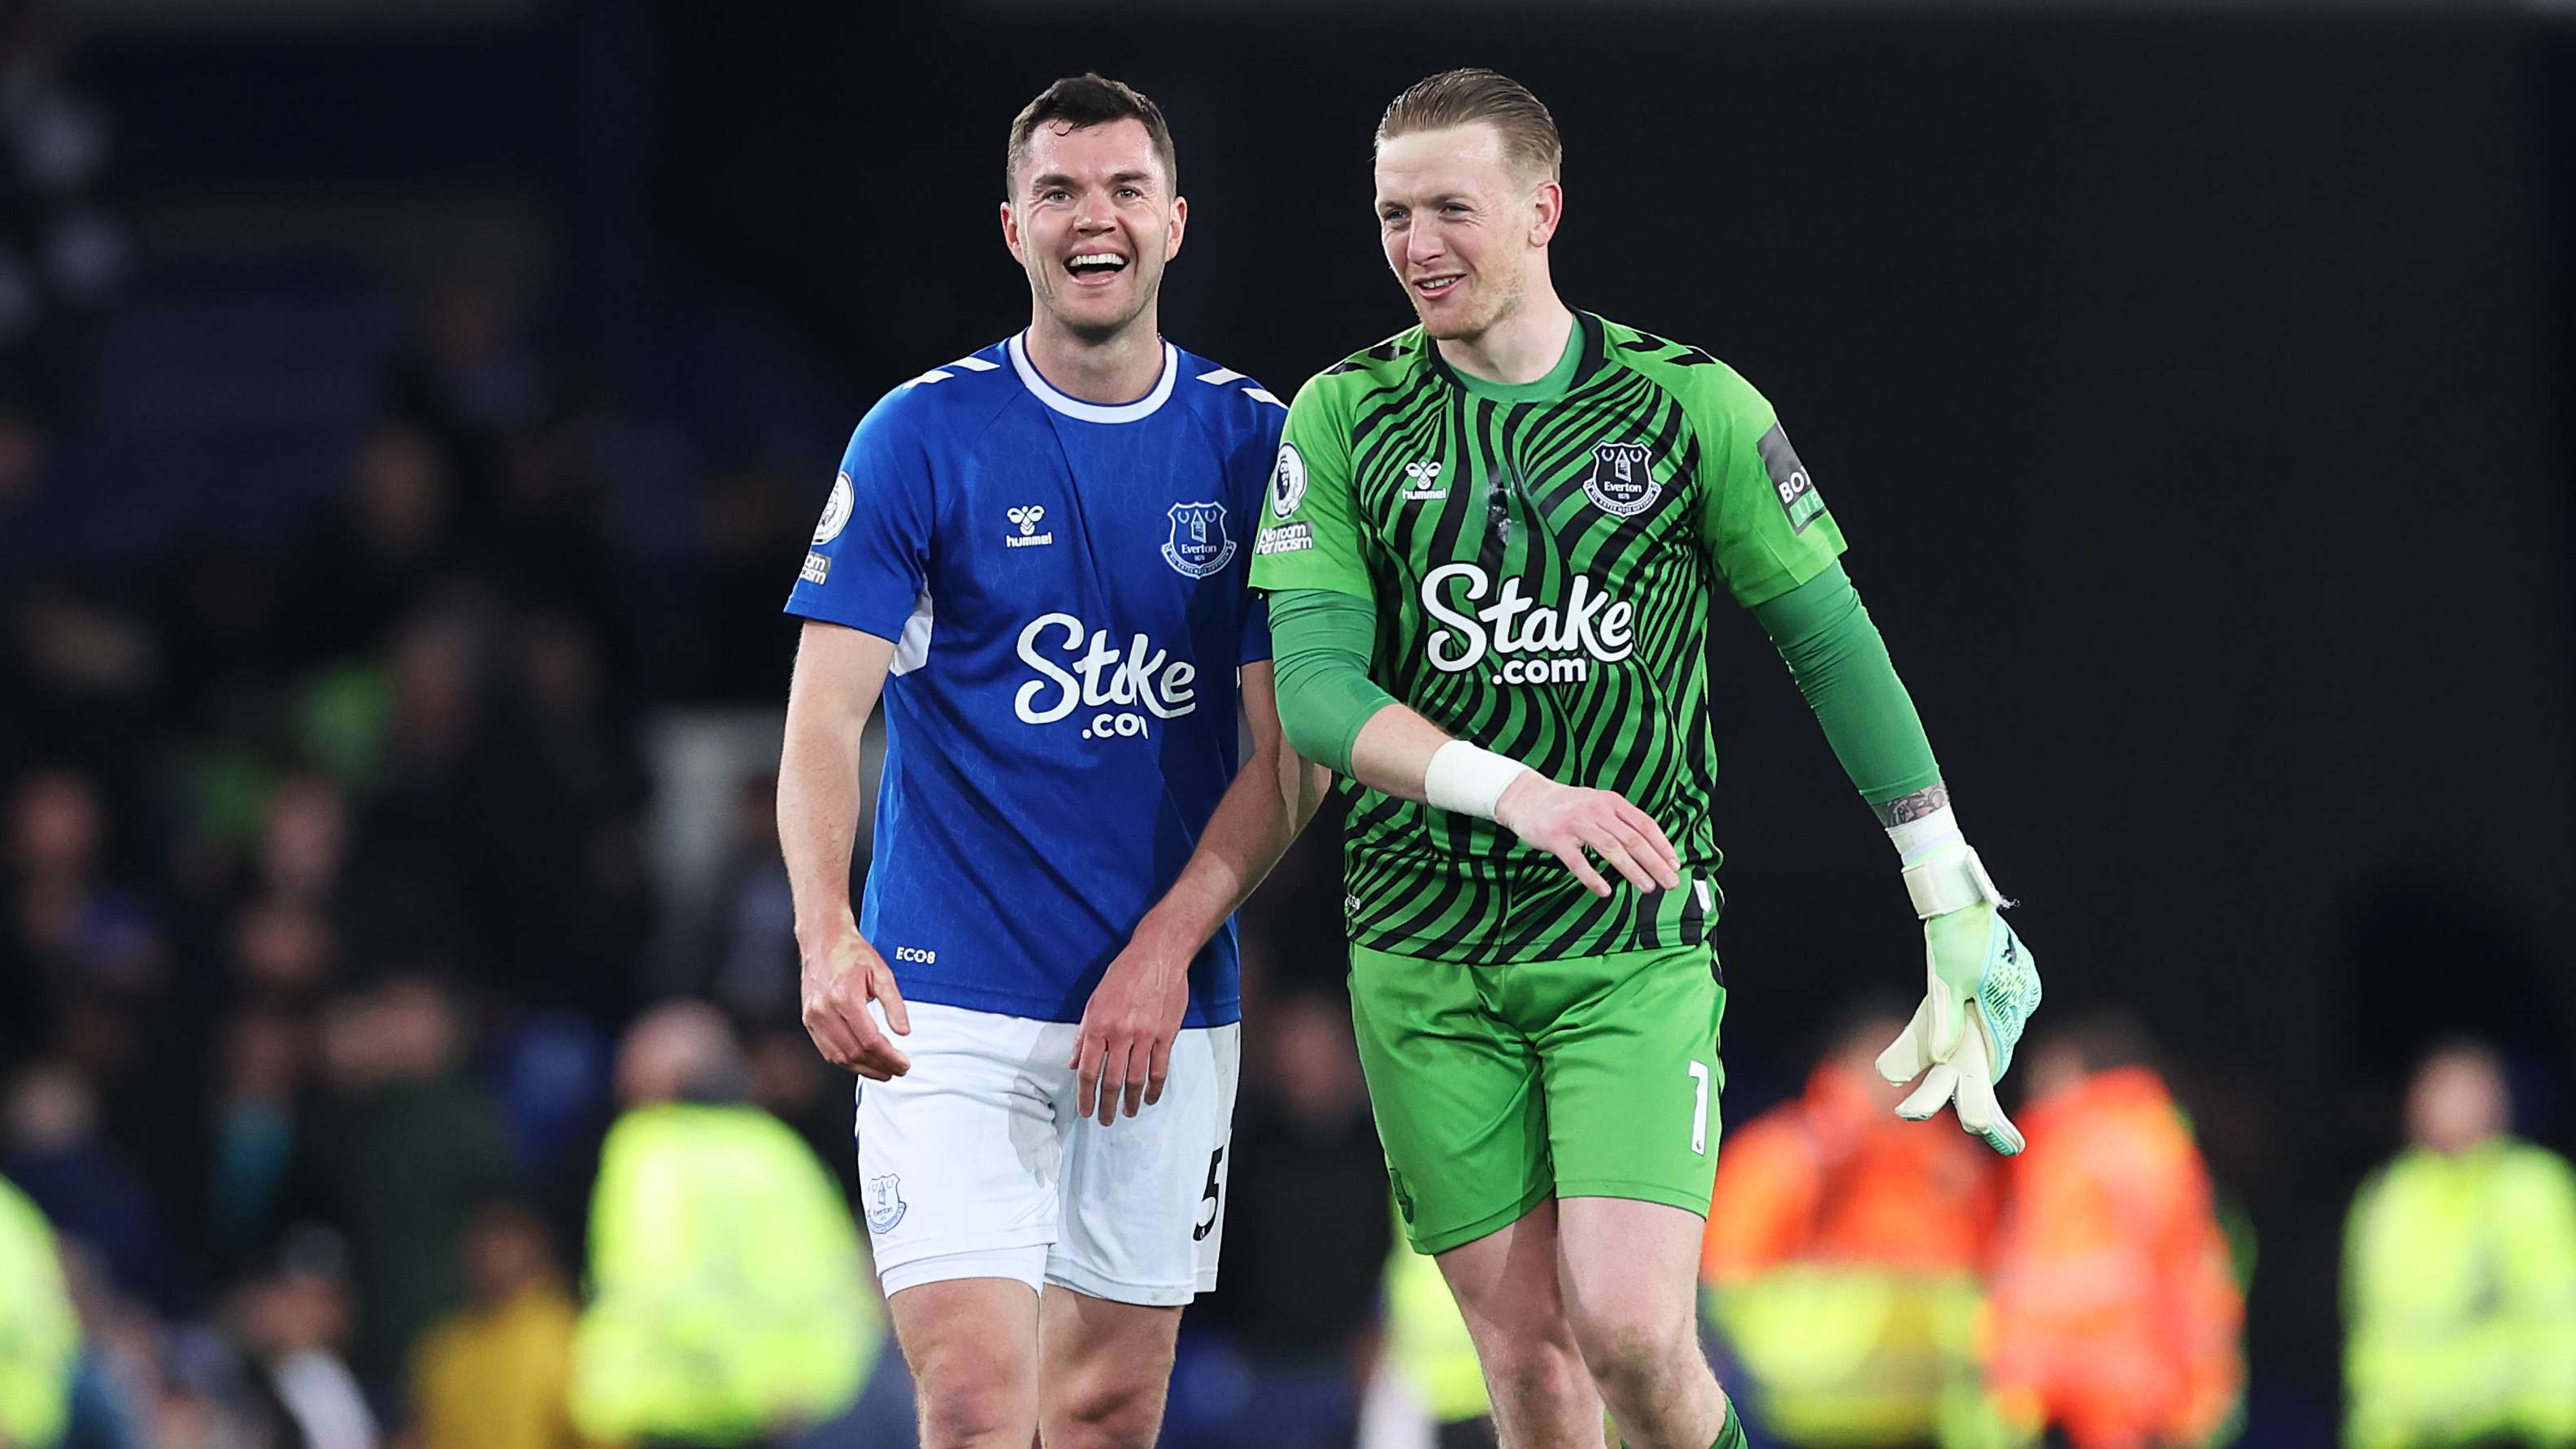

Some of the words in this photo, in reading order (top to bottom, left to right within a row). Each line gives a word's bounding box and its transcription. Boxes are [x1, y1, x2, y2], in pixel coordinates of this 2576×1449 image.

[1402, 487, 1447, 500] hummel
[1603, 481, 1642, 493] Everton
[1006, 531, 1053, 547] hummel
[1259, 528, 1277, 543] No
[1276, 524, 1307, 541] room
[1181, 543, 1217, 555] Everton
[1274, 537, 1312, 552] racism
[804, 554, 826, 571] om
[1421, 562, 1634, 672] Stake
[1014, 612, 1197, 725] Stake
[1491, 657, 1586, 685] .com
[895, 946, 936, 964] ECO8
[1687, 1059, 1709, 1158] 1
[1193, 1145, 1225, 1242] 5
